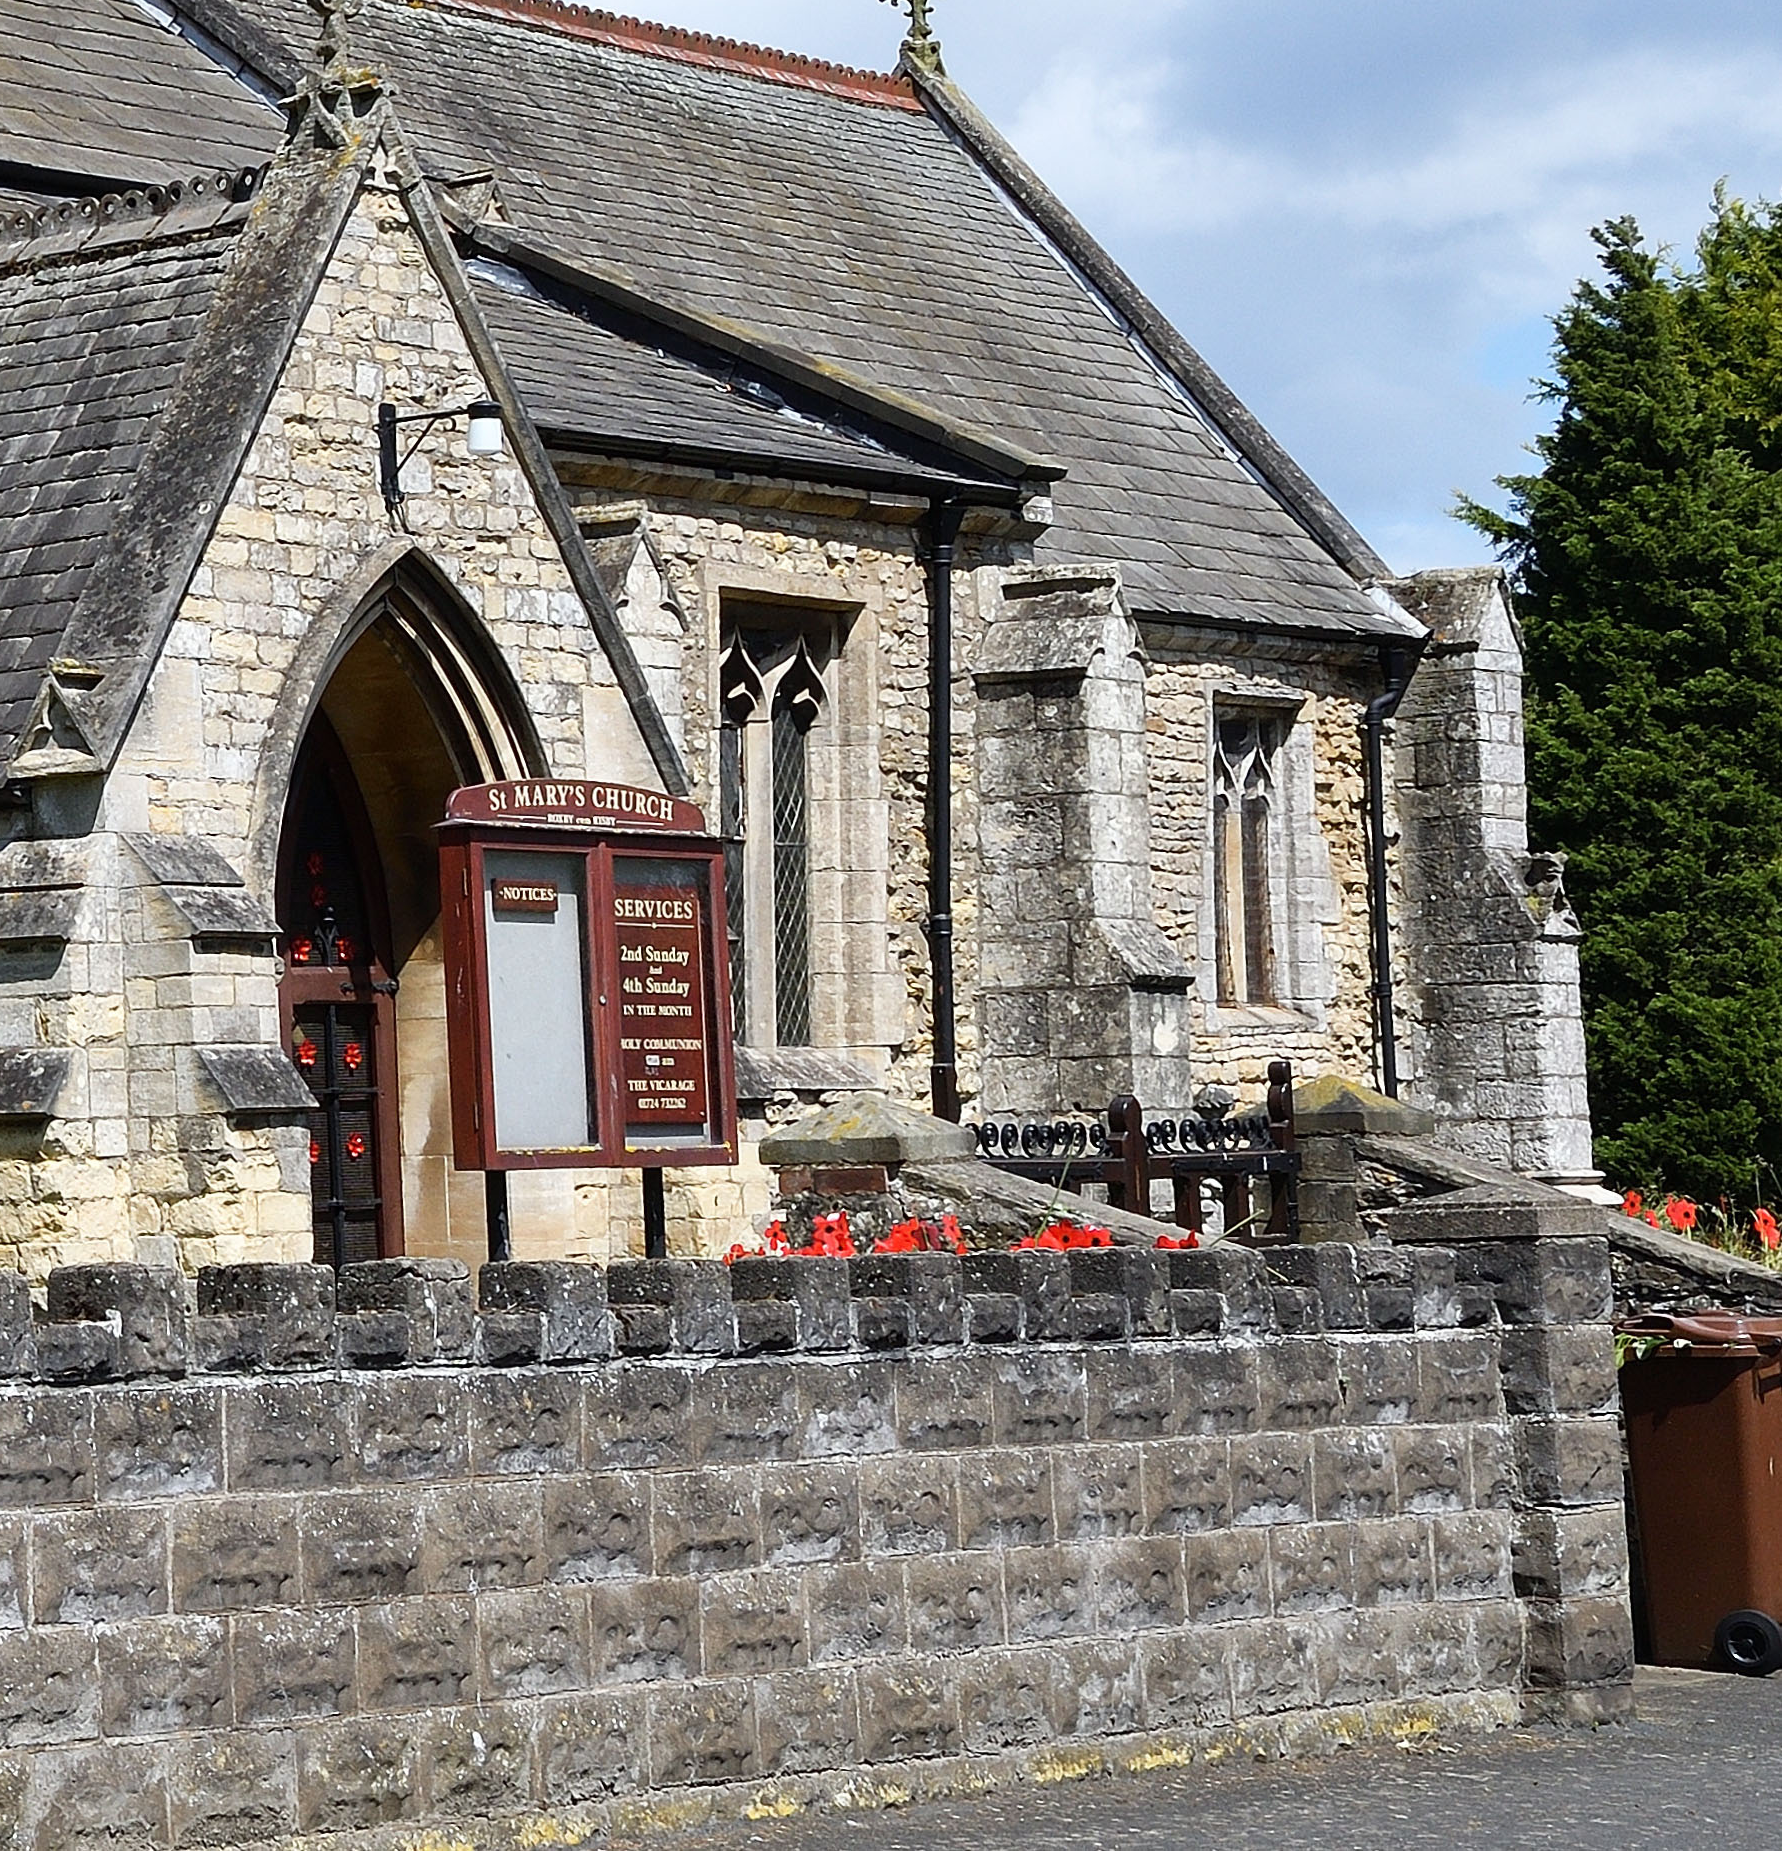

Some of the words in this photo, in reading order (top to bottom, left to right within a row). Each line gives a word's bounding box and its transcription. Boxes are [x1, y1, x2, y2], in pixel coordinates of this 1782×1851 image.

[489, 788, 508, 811] St
[514, 784, 585, 808] MARY'S
[592, 786, 674, 821] CHURCH
[503, 886, 554, 901] NOTICES
[614, 898, 693, 919] SERVICES
[620, 945, 643, 961] 2nd
[645, 945, 690, 966] Sunday
[623, 977, 643, 993] 4th
[646, 977, 690, 998] Sunday
[623, 1004, 634, 1016] IN
[636, 1005, 656, 1016] THE
[658, 1005, 692, 1017] MONTH
[643, 1038, 702, 1050] COMMUNION
[627, 1080, 648, 1091] THE
[649, 1080, 696, 1091] VICARAGE
